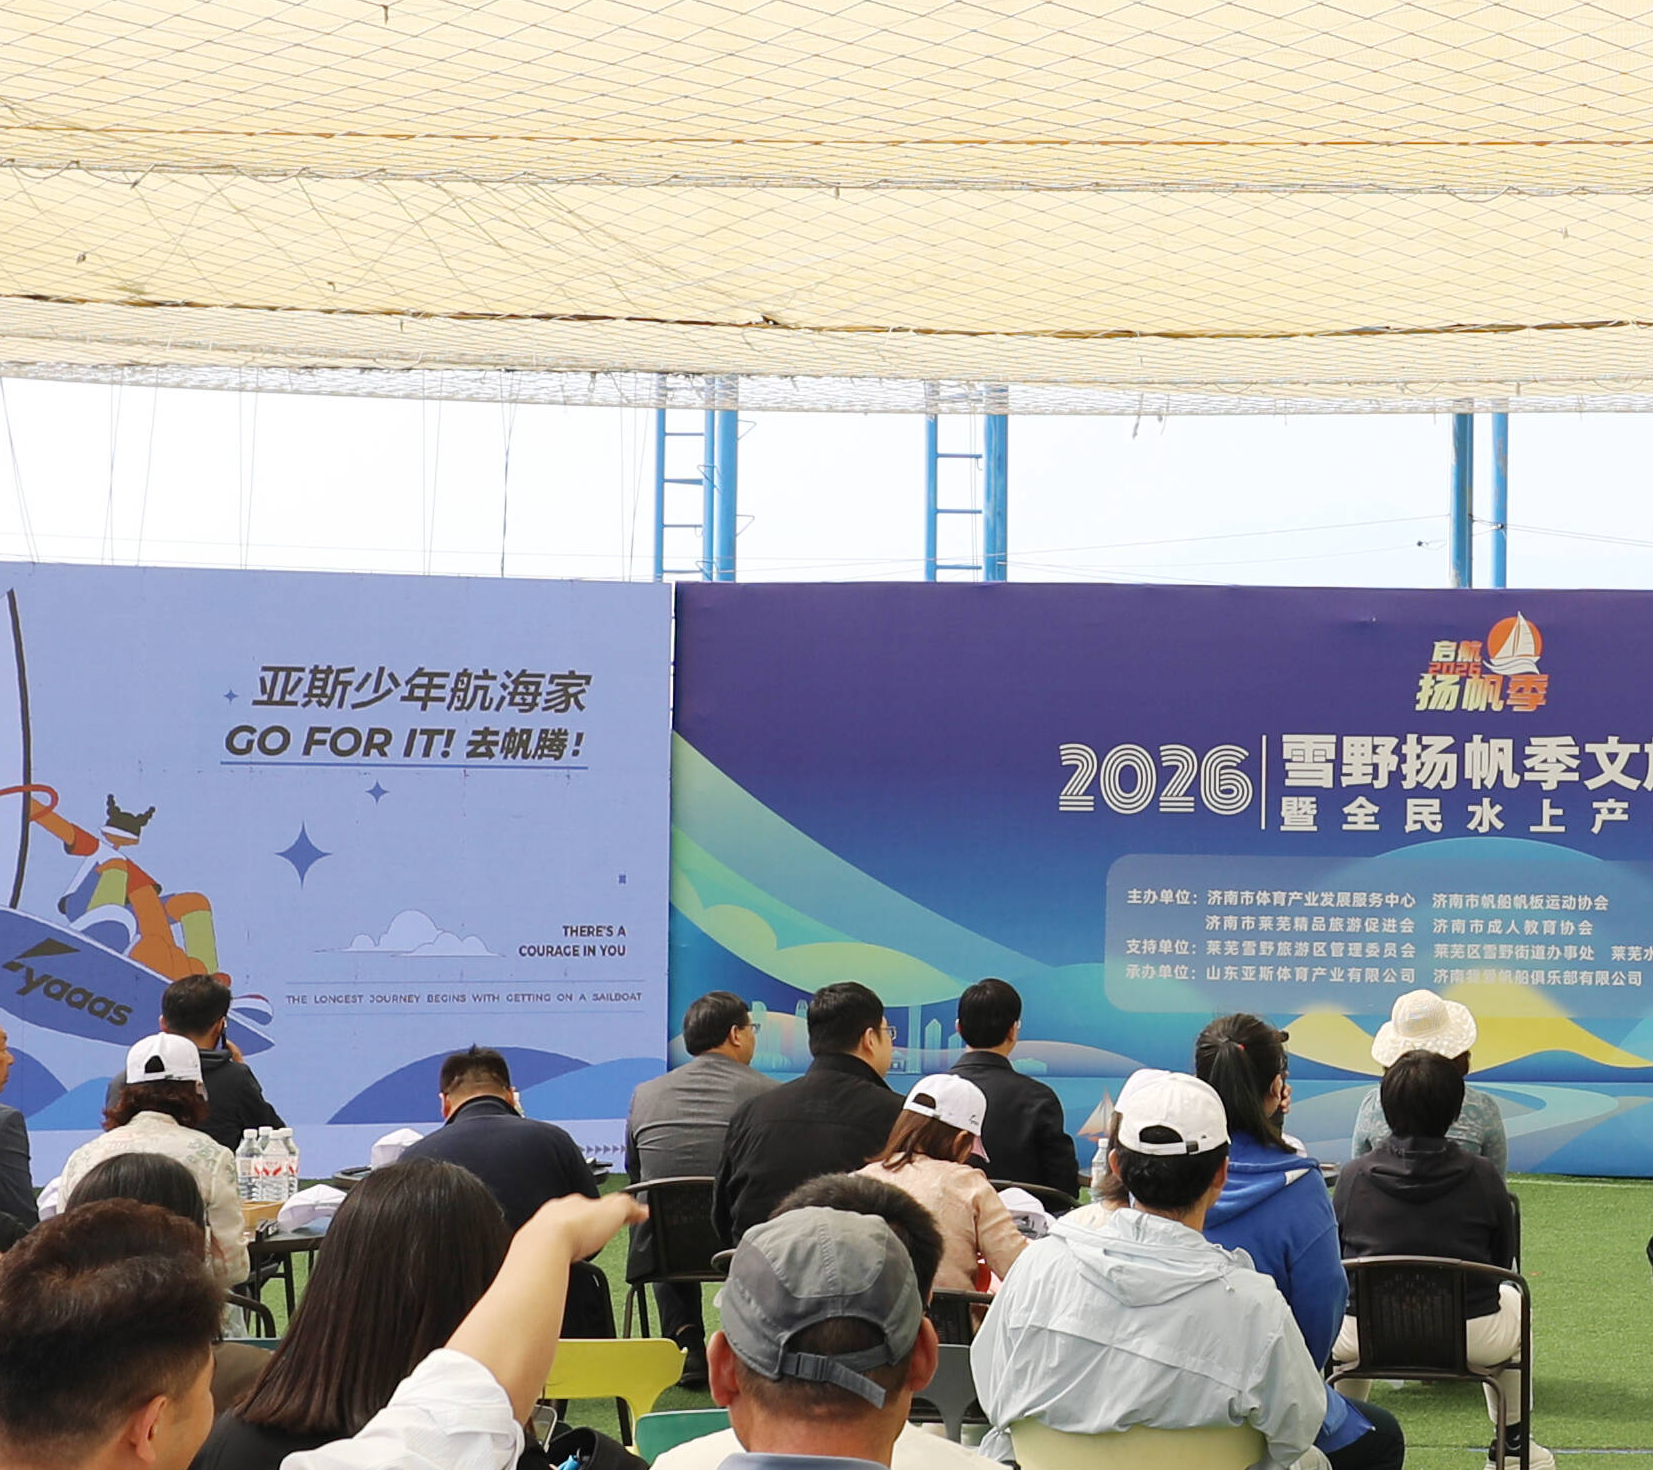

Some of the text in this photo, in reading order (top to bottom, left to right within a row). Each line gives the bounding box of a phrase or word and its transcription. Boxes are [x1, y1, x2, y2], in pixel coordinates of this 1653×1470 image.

[1432, 640, 1483, 662] 启航
[252, 664, 593, 713] 亚斯少年航海家
[1415, 674, 1549, 711] 扬帆季
[225, 724, 291, 757] GO
[302, 725, 393, 758] FOR
[403, 727, 453, 759] IT!
[1058, 743, 1253, 815] 2026
[1207, 890, 1416, 908] 济南市体育产业发展服务中心
[1432, 893, 1609, 911] 济南市帆船帆板运动协会
[562, 925, 627, 938] THERE'S A
[1206, 915, 1594, 936] 济南市莱芜精品旅游促进会 济南市成人教育协会
[518, 945, 627, 958] COURAGE IN YOU
[1206, 940, 1416, 958] 莱芜雪野旅游区管理委员会
[1434, 943, 1595, 961] 莱芜区雪野街道办事处
[1206, 965, 1415, 984] 山东亚斯体育产业有限公司
[1433, 968, 1642, 987] 济南我爱帆船俱乐部有限公司
[15, 965, 134, 1027] yaaas
[286, 992, 642, 1004] THE LONGEST JOURNEY BEGINS WITH GETTING ON A SAILBOAT
